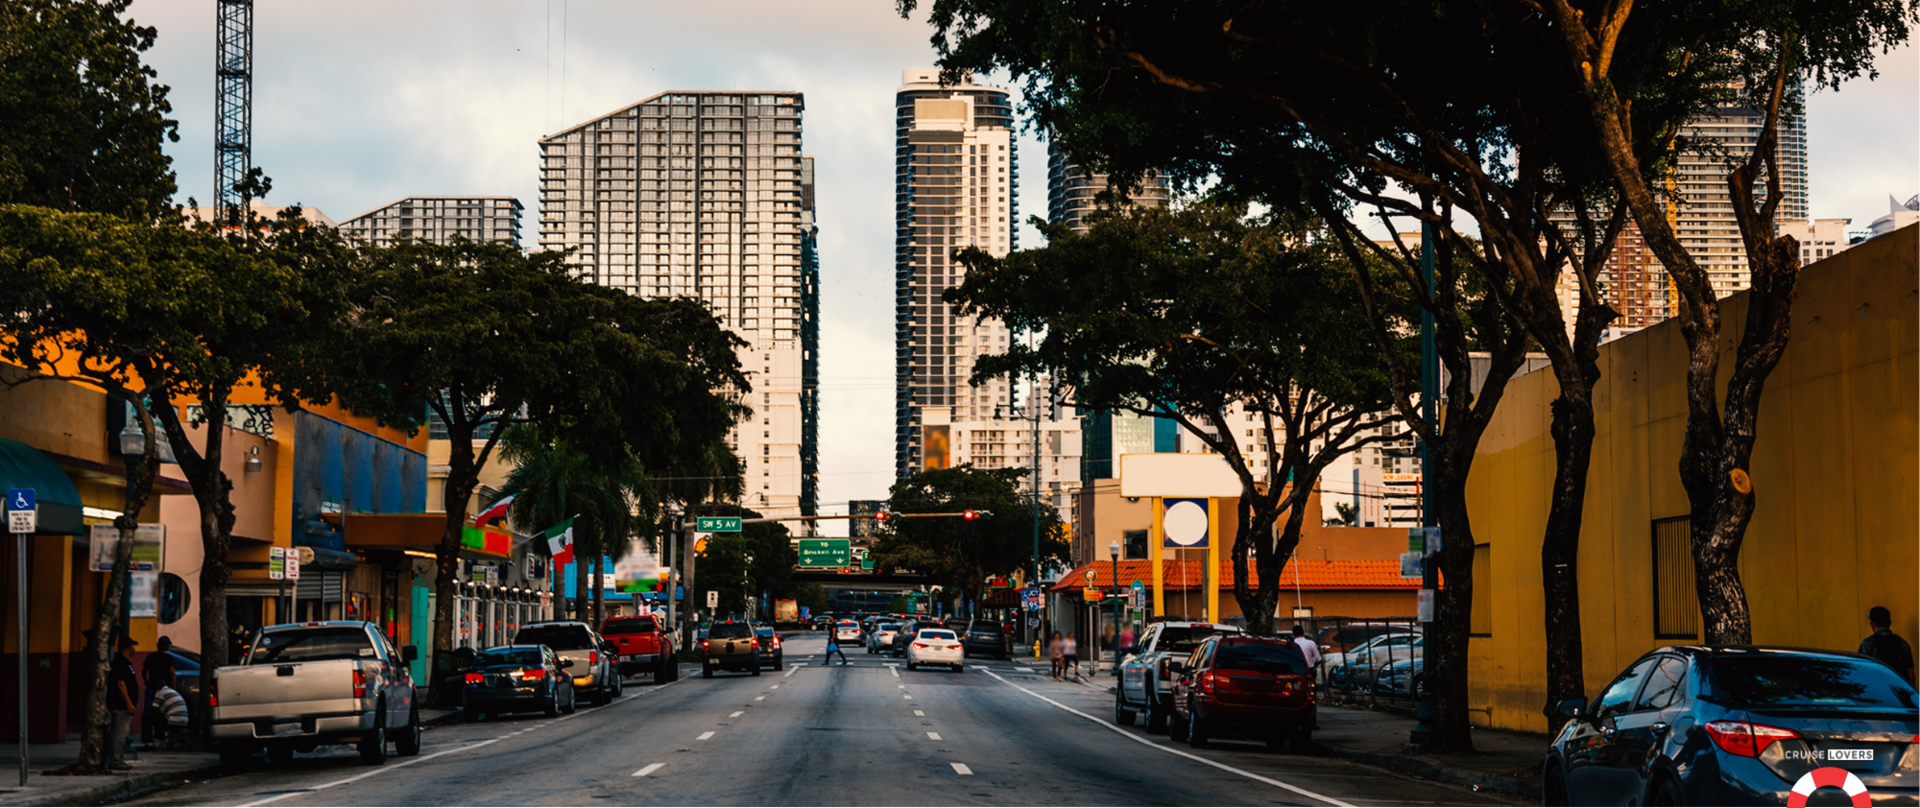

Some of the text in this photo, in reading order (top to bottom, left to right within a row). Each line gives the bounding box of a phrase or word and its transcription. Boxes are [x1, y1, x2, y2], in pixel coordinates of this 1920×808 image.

[702, 520, 736, 529] SW 5 AV
[1029, 601, 1038, 610] 95
